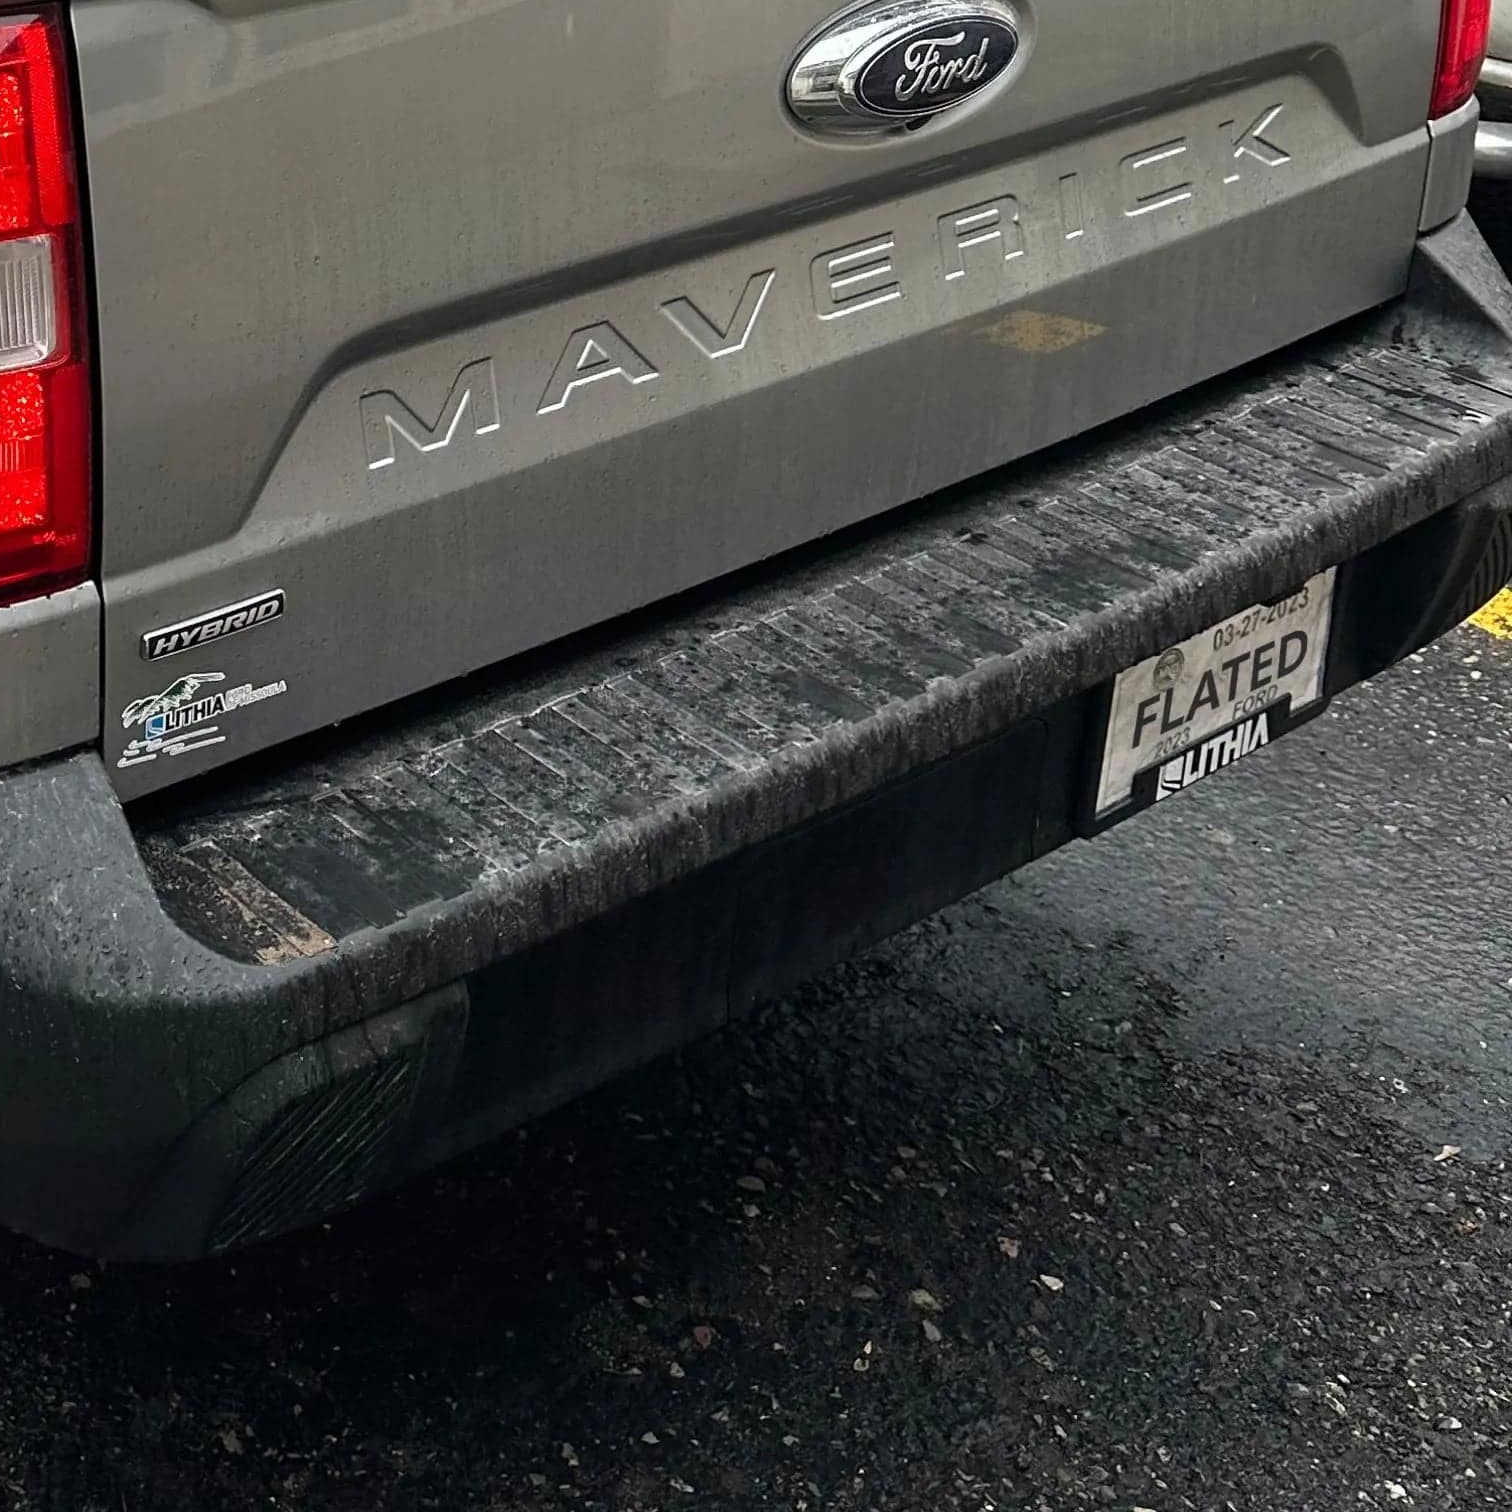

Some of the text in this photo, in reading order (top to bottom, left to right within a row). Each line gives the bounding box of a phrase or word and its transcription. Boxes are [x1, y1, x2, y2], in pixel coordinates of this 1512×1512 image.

[894, 31, 990, 102] Ford
[358, 103, 1291, 471] MAVERICK
[153, 599, 280, 656] HYBRID
[164, 695, 225, 731] LITHIA
[1132, 630, 1308, 749] FLATED
[1232, 684, 1278, 721] FORD
[1182, 711, 1269, 788] LITHIA
